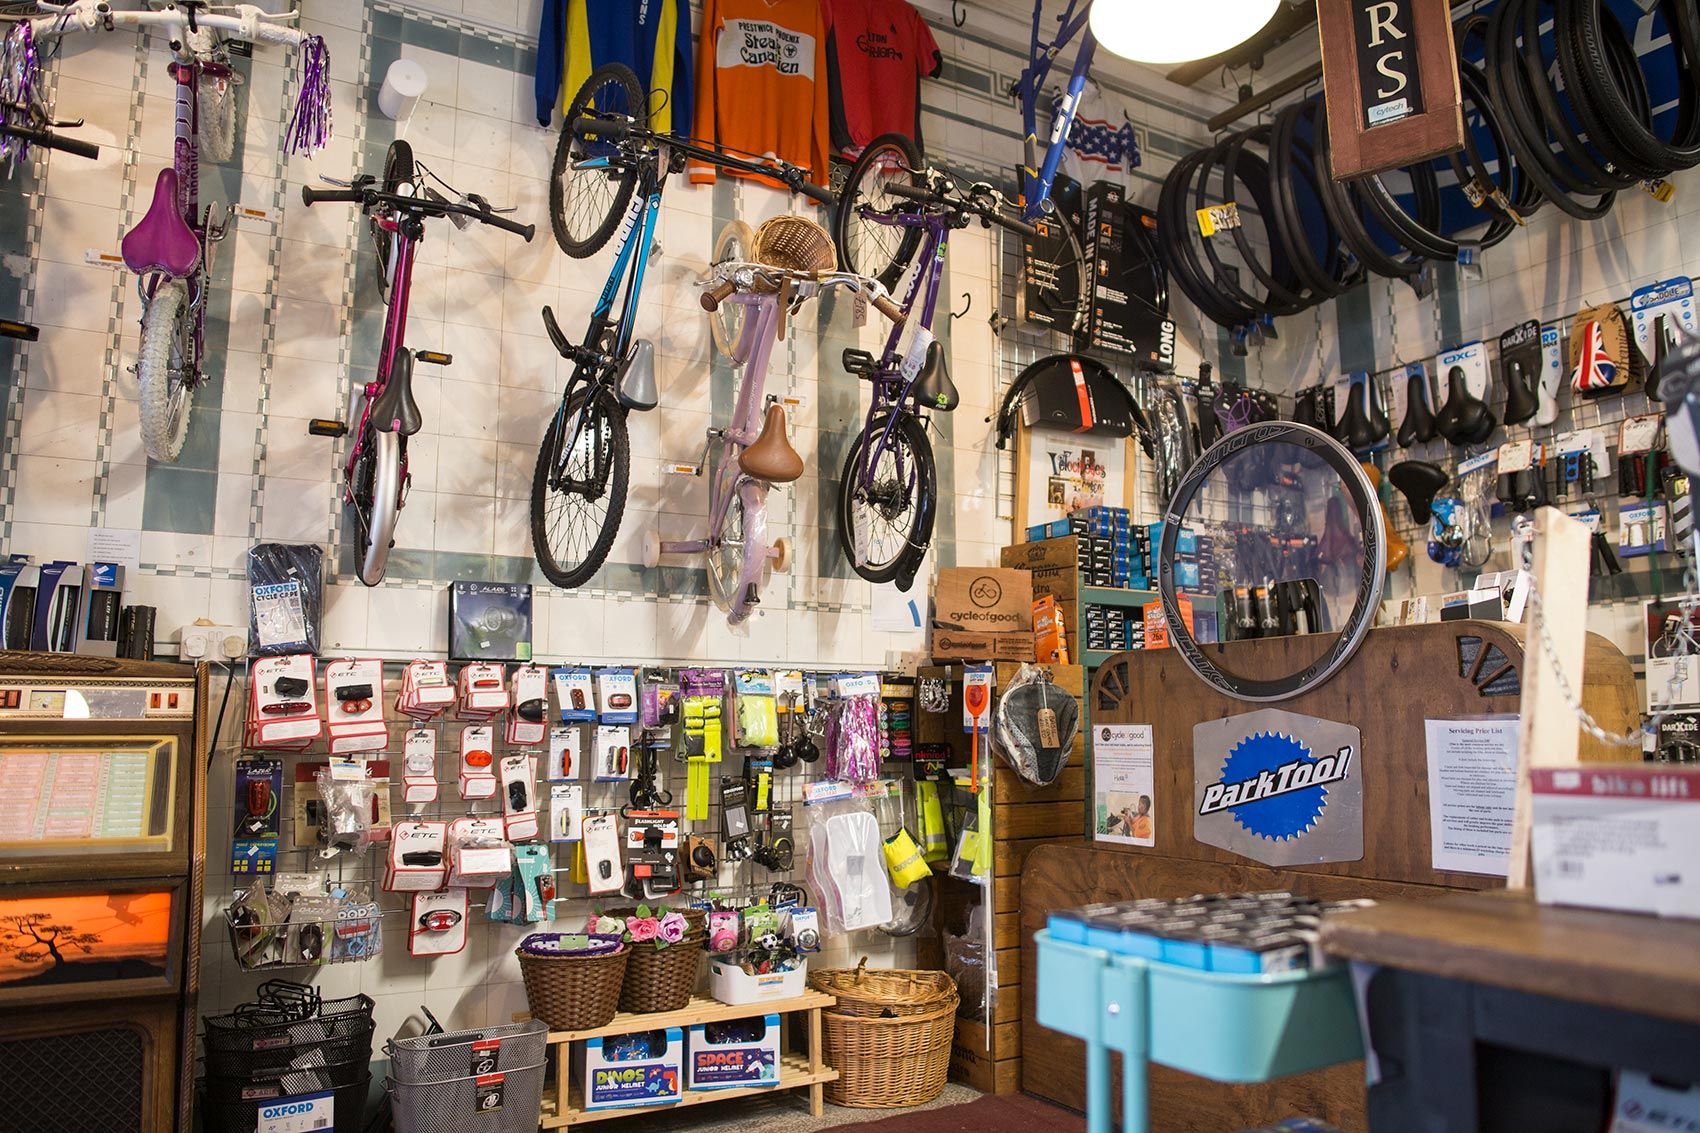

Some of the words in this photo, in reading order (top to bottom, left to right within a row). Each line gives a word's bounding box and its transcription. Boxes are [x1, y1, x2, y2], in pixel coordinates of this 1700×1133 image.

[741, 47, 799, 73] Canaien
[1376, 103, 1404, 117] cytech
[1086, 197, 1098, 241] MADE
[1085, 243, 1094, 258] IN
[1159, 321, 1174, 365] LONG
[255, 583, 298, 597] OXFORD
[256, 593, 278, 602] CYCLE
[950, 610, 1020, 624] cycleofgood
[846, 680, 872, 688] OXFOD
[1661, 719, 1698, 733] DARXIDE
[915, 751, 946, 759] nimrod
[1592, 775, 1646, 796] bike
[1651, 776, 1690, 797] lift
[893, 854, 920, 873] OXFORD
[698, 1052, 744, 1067] SPACE
[697, 1065, 719, 1073] JUNIOR
[721, 1064, 744, 1072] HELMET
[597, 1068, 646, 1085] DINOS
[596, 1083, 619, 1092] JUNIOR
[621, 1082, 646, 1090] HELMET
[263, 1102, 314, 1119] OXFORD
